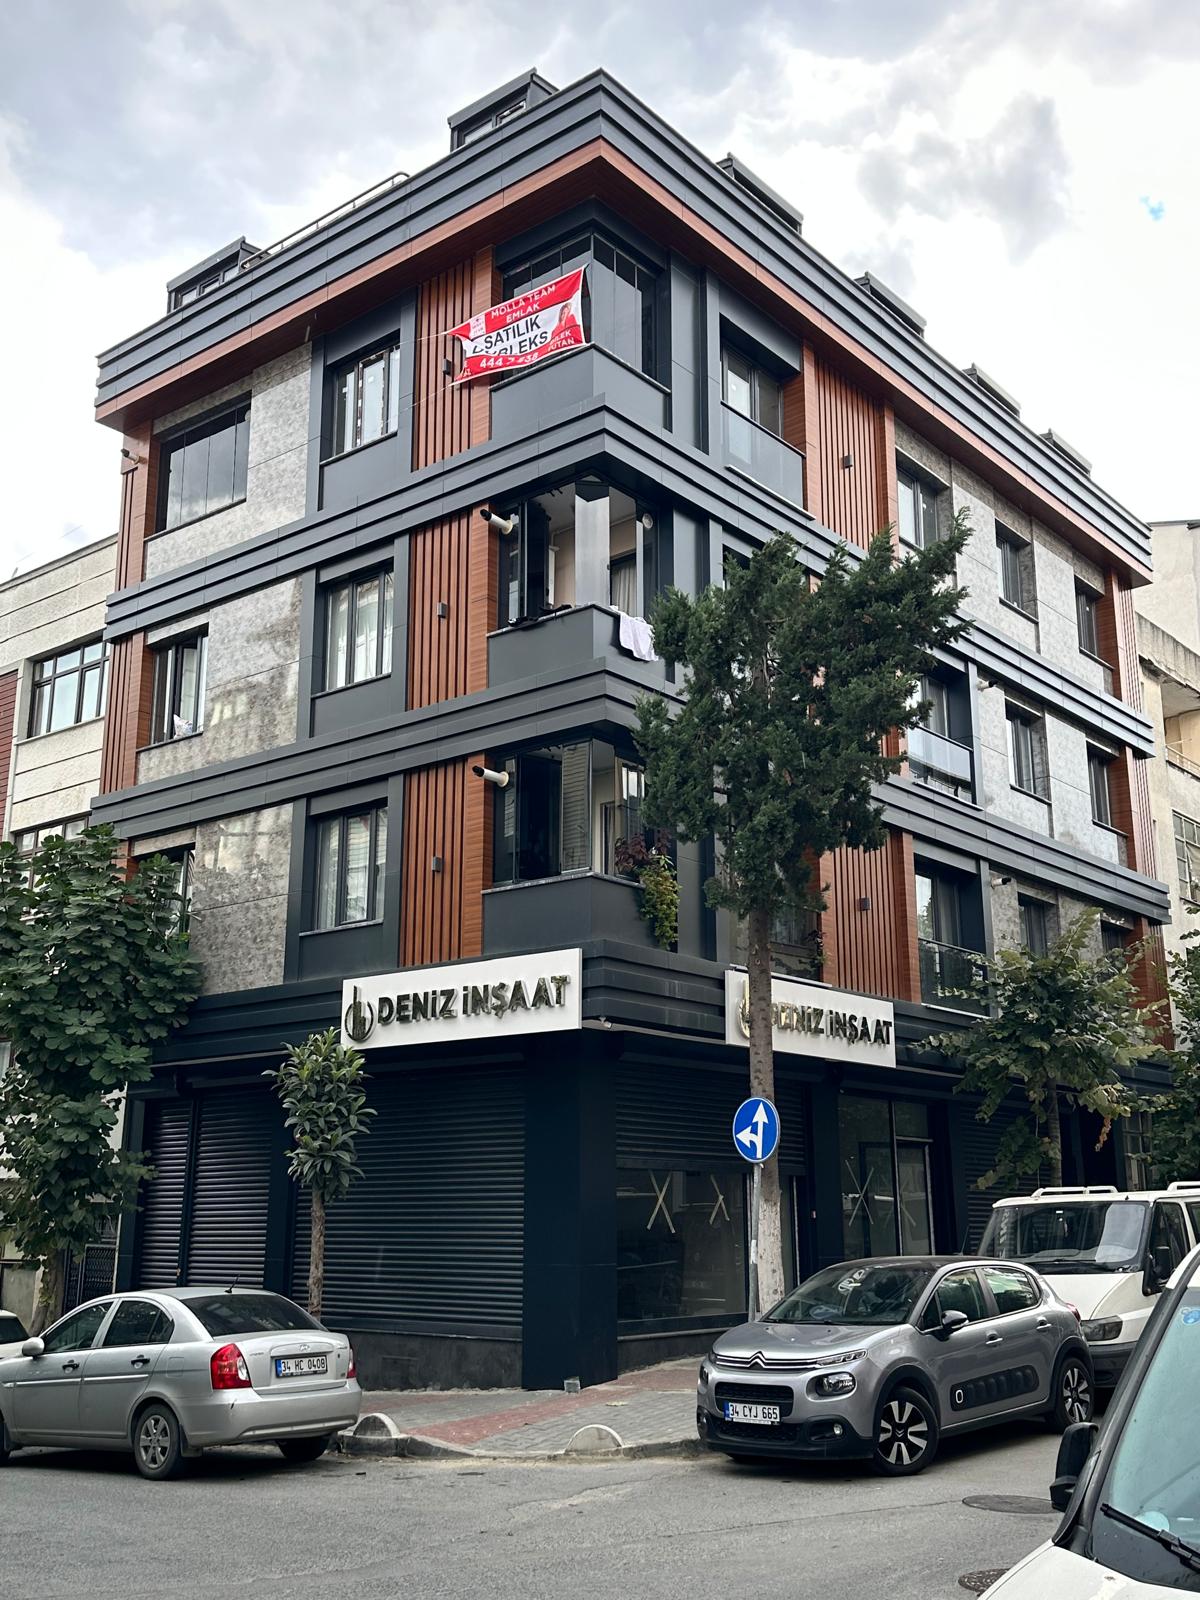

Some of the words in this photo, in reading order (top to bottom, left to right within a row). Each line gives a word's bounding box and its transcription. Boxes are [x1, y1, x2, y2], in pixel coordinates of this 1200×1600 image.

[491, 300, 525, 319] MOLLA
[529, 285, 556, 301] TEAM
[506, 303, 540, 323] EMLAK
[484, 315, 541, 350] SATILIK
[480, 357, 503, 368] 444
[378, 988, 457, 1025] DENİZ
[462, 975, 571, 1018] İNŞAAT
[828, 1009, 892, 1045] İNŞAAT
[282, 1361, 291, 1372] 34
[730, 1404, 739, 1416] 34
[743, 1405, 758, 1418] CYJ
[762, 1406, 778, 1420] 665
